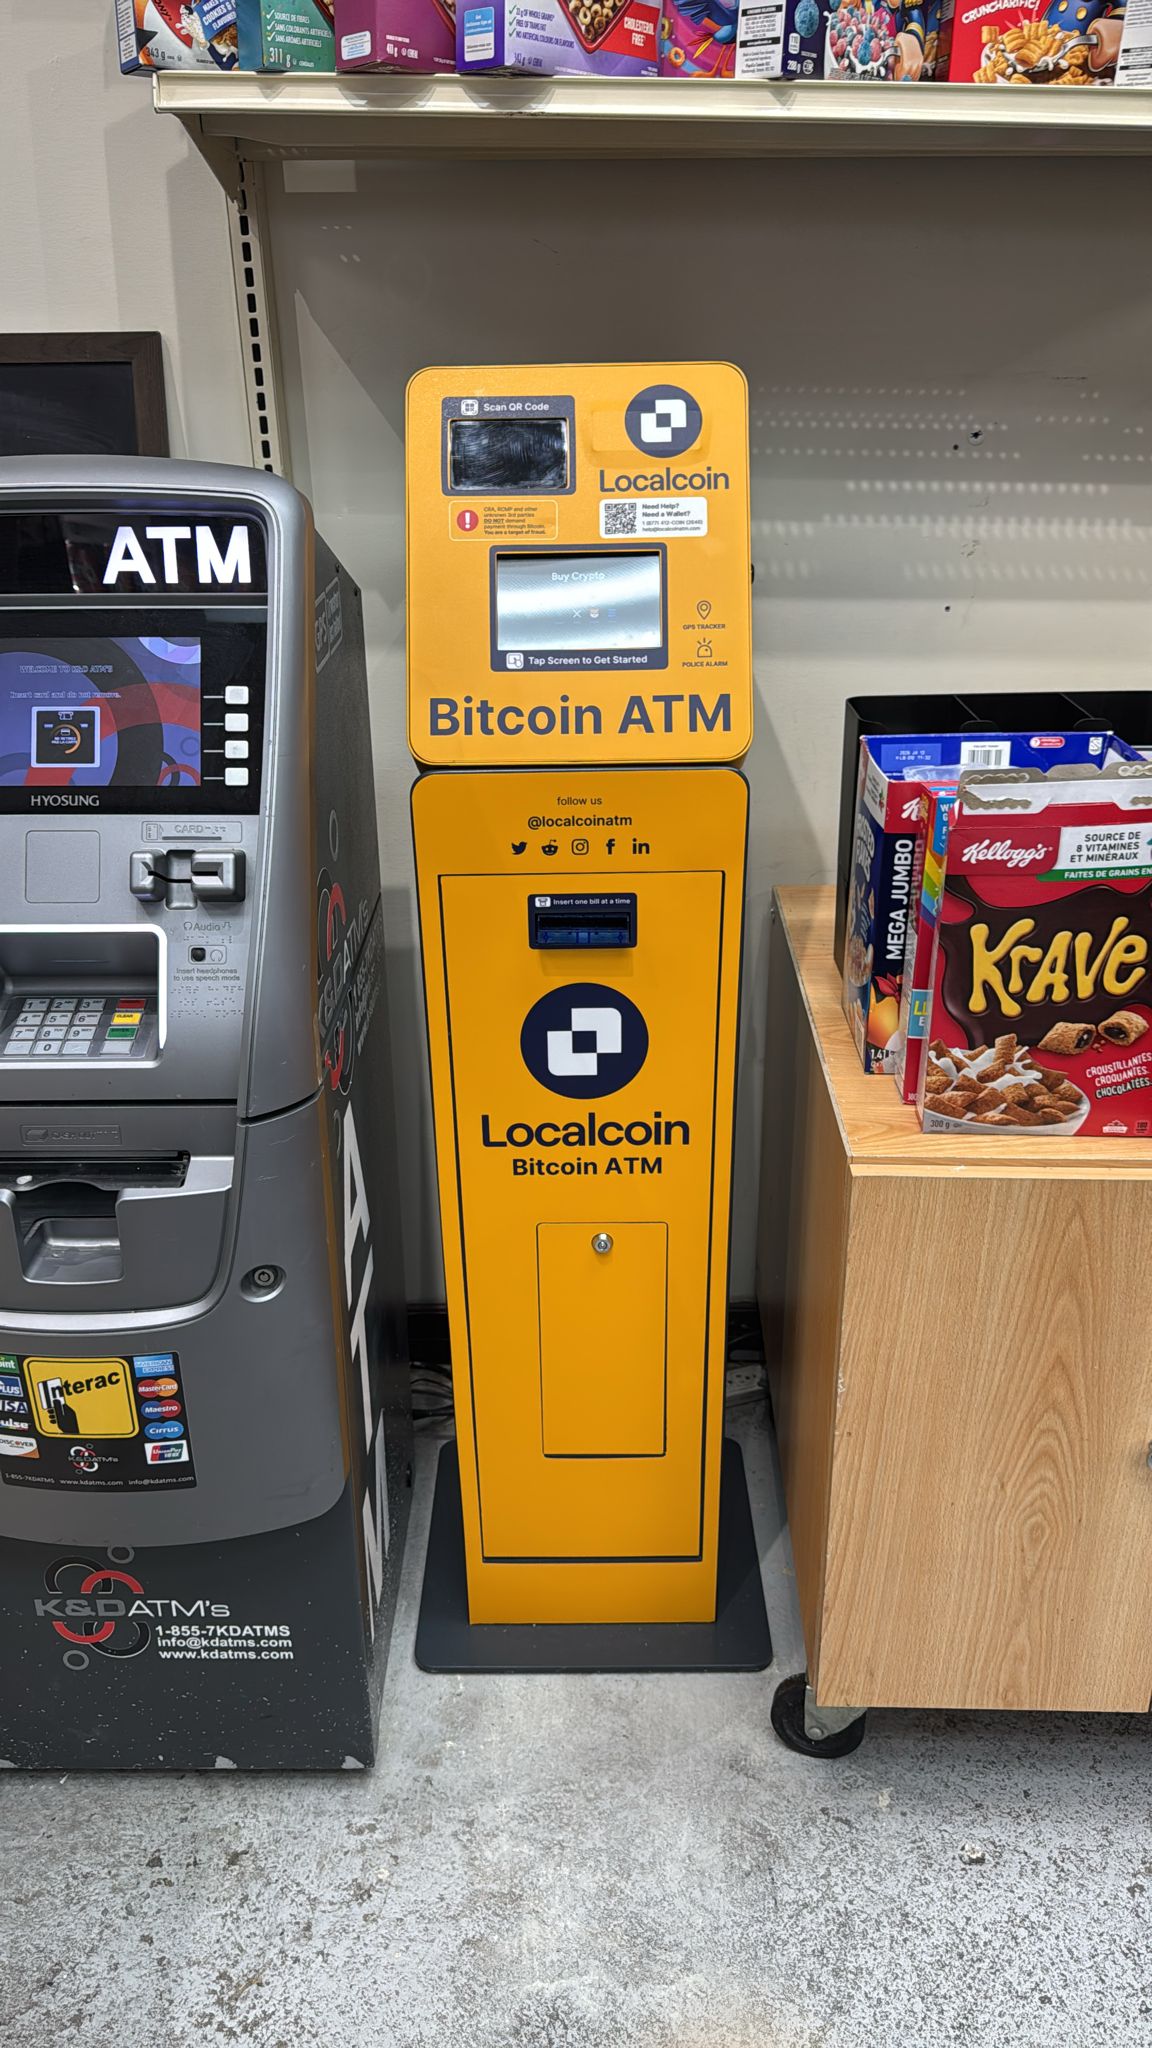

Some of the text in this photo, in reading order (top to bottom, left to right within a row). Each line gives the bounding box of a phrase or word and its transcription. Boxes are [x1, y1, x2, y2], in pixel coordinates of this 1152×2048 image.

[270, 47, 283, 63] 311
[286, 55, 291, 68] g
[484, 401, 549, 412] Scan QR Code
[599, 466, 730, 493] Localcoin
[642, 503, 679, 512] Need Help?
[102, 525, 252, 584] ATM
[551, 570, 605, 583] Buy Crypto
[528, 654, 648, 666] Tap Screen to Get Started
[429, 693, 732, 736] Bitcoin ATM
[31, 794, 99, 807] HYOSUNG
[557, 796, 602, 806] follow us
[527, 815, 632, 830] @localcoinatm
[1084, 831, 1141, 843] SOURCE DE
[961, 838, 1047, 868] Kellogg's
[1076, 842, 1140, 853] 8 VITAMINES
[1070, 850, 1138, 863] ET MINÉRAUX
[889, 839, 913, 905] JUMBO
[1064, 870, 1092, 879] FAITES
[1095, 870, 1106, 878] DE
[1109, 868, 1139, 877] GRAINS
[193, 922, 221, 931] Audio
[884, 909, 906, 960] MEGA
[198, 968, 237, 976] headphones
[193, 975, 220, 983] speech
[26, 1000, 90, 1009] 1 2 3
[20, 1015, 29, 1023] 4
[49, 1015, 57, 1023] 5
[78, 1015, 86, 1023] 6
[15, 1030, 80, 1038] 7 8 9
[44, 1043, 51, 1052] 0
[481, 1111, 690, 1148] Localcoin
[930, 1119, 950, 1130] 300 g
[512, 1156, 662, 1176] Bitcoin ATM
[138, 1383, 178, 1392] MasterCard
[144, 1404, 178, 1414] Maestro
[149, 1425, 179, 1434] Cirrus
[5, 1473, 194, 1486] 1-855-7KDATMS www.kdatms.com info@kdatms.com
[34, 1598, 231, 1617] K&DATM's
[155, 1625, 291, 1637] 1-855-7KDATMS
[157, 1637, 292, 1649] info@kdatms.com
[159, 1649, 294, 1660] www.kdatms.com
